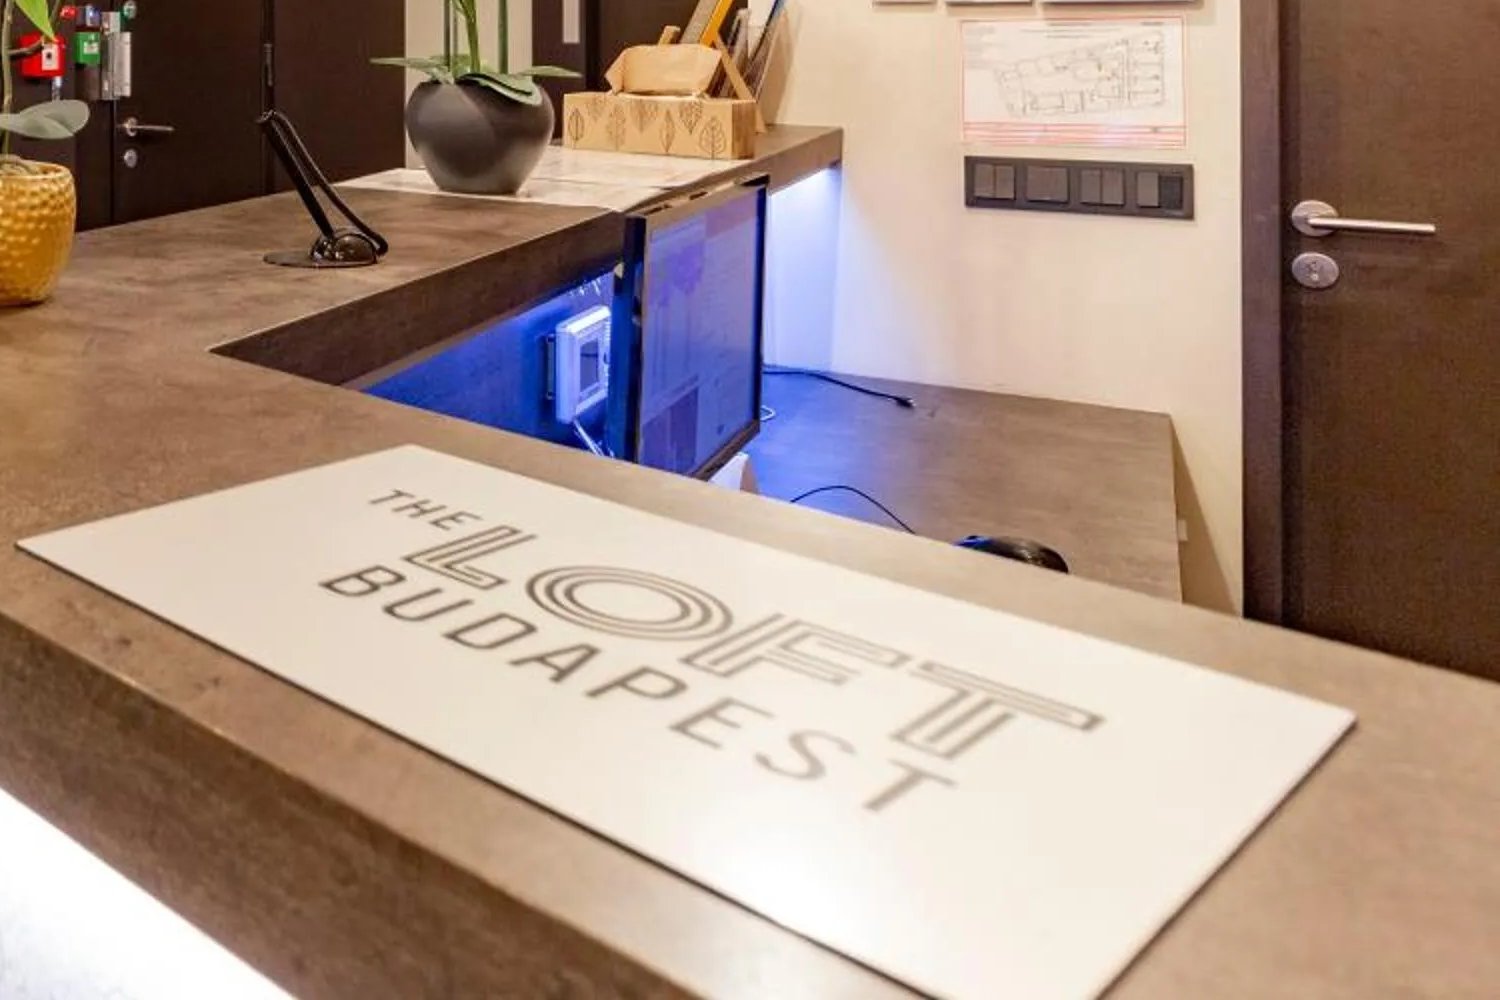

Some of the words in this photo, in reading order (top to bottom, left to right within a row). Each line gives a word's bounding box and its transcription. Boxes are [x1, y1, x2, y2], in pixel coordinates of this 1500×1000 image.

[368, 488, 485, 531] THE
[318, 564, 959, 811] BUDAPEST
[401, 524, 1105, 761] LOFT
